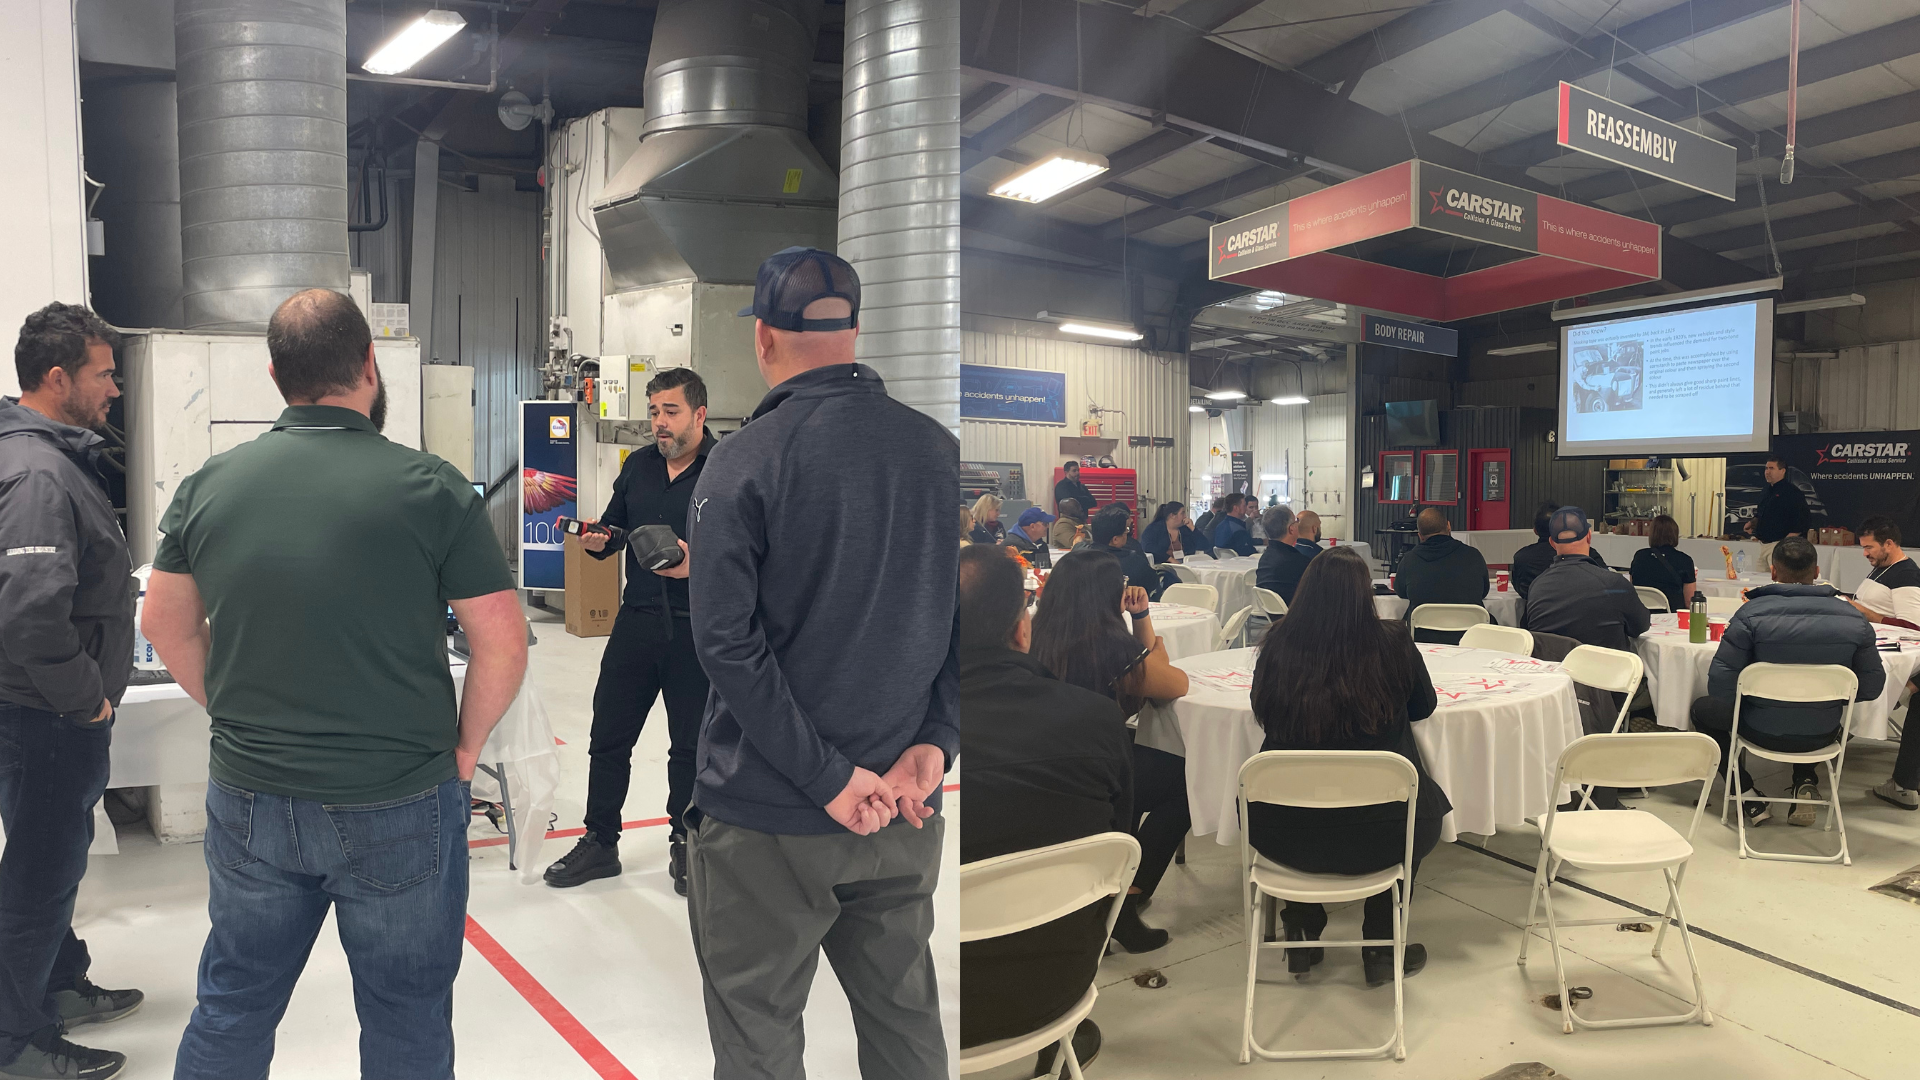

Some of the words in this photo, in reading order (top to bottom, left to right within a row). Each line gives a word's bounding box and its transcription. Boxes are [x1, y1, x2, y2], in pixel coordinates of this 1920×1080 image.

[1587, 108, 1677, 164] REASSEMBLY
[1293, 223, 1305, 232] This
[1306, 221, 1312, 229] is
[1312, 215, 1332, 227] where
[1334, 204, 1366, 222] accidents
[1368, 191, 1408, 213] unhappen!
[1446, 188, 1522, 224] CARSTAR
[1463, 212, 1485, 224] Collision
[1490, 218, 1504, 228] Glass
[1504, 222, 1522, 232] Service
[1228, 222, 1278, 252] CARSTAR
[1542, 220, 1556, 232] This
[1558, 224, 1564, 234] is
[1566, 227, 1587, 240] where
[1588, 233, 1621, 247] accidents
[1622, 242, 1656, 255] unhappen!
[1375, 324, 1396, 338] BODY
[1398, 328, 1424, 344] REPAIR
[1591, 326, 1606, 334] Know?
[964, 391, 1004, 400] accidents
[1005, 394, 1046, 403] unhappen!
[1084, 425, 1098, 436] EXIT
[1831, 443, 1908, 457] CARSTAR
[1810, 472, 1832, 480] Where
[1834, 472, 1868, 480] accidents
[526, 522, 565, 546] 100
